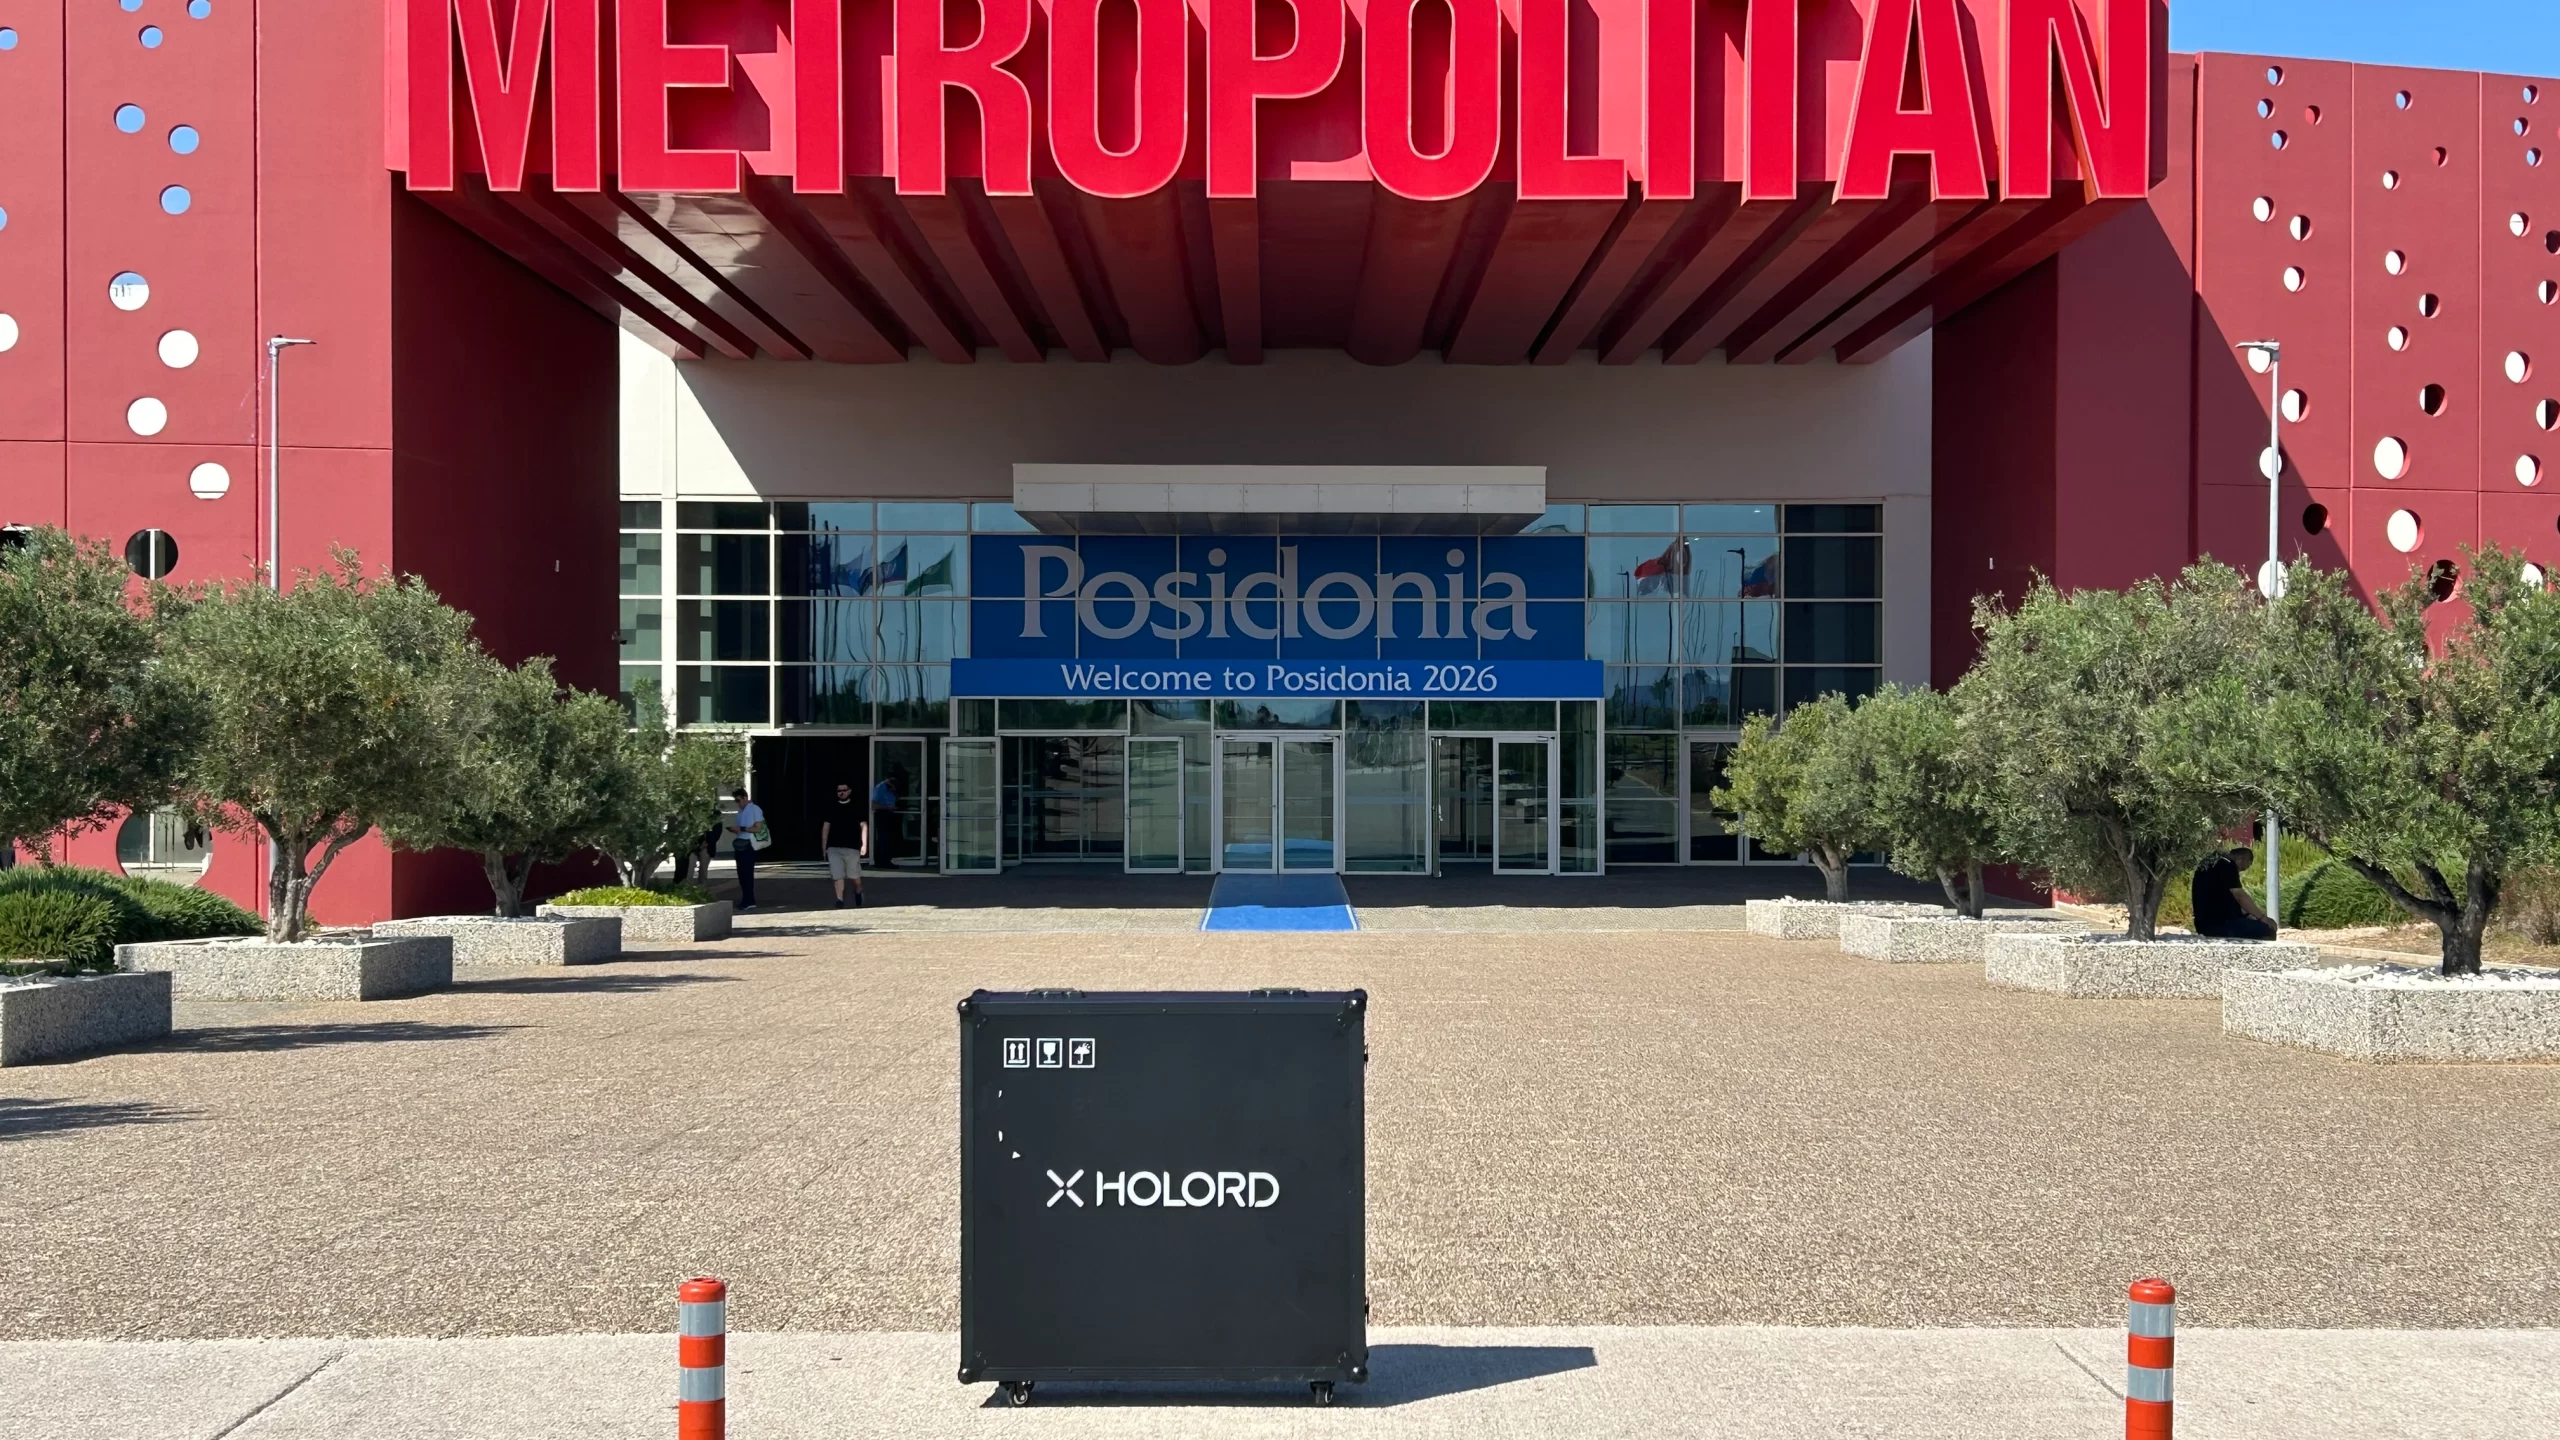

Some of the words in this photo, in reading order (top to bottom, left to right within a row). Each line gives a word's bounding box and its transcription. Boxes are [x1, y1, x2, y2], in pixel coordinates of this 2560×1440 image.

[1019, 544, 1538, 641] Posidonia
[1060, 664, 1212, 691] Welcome
[1223, 667, 1256, 691] to
[1267, 665, 1412, 691] Posidonia
[1423, 665, 1497, 692] 2026
[1096, 1170, 1280, 1208] HOLORD
